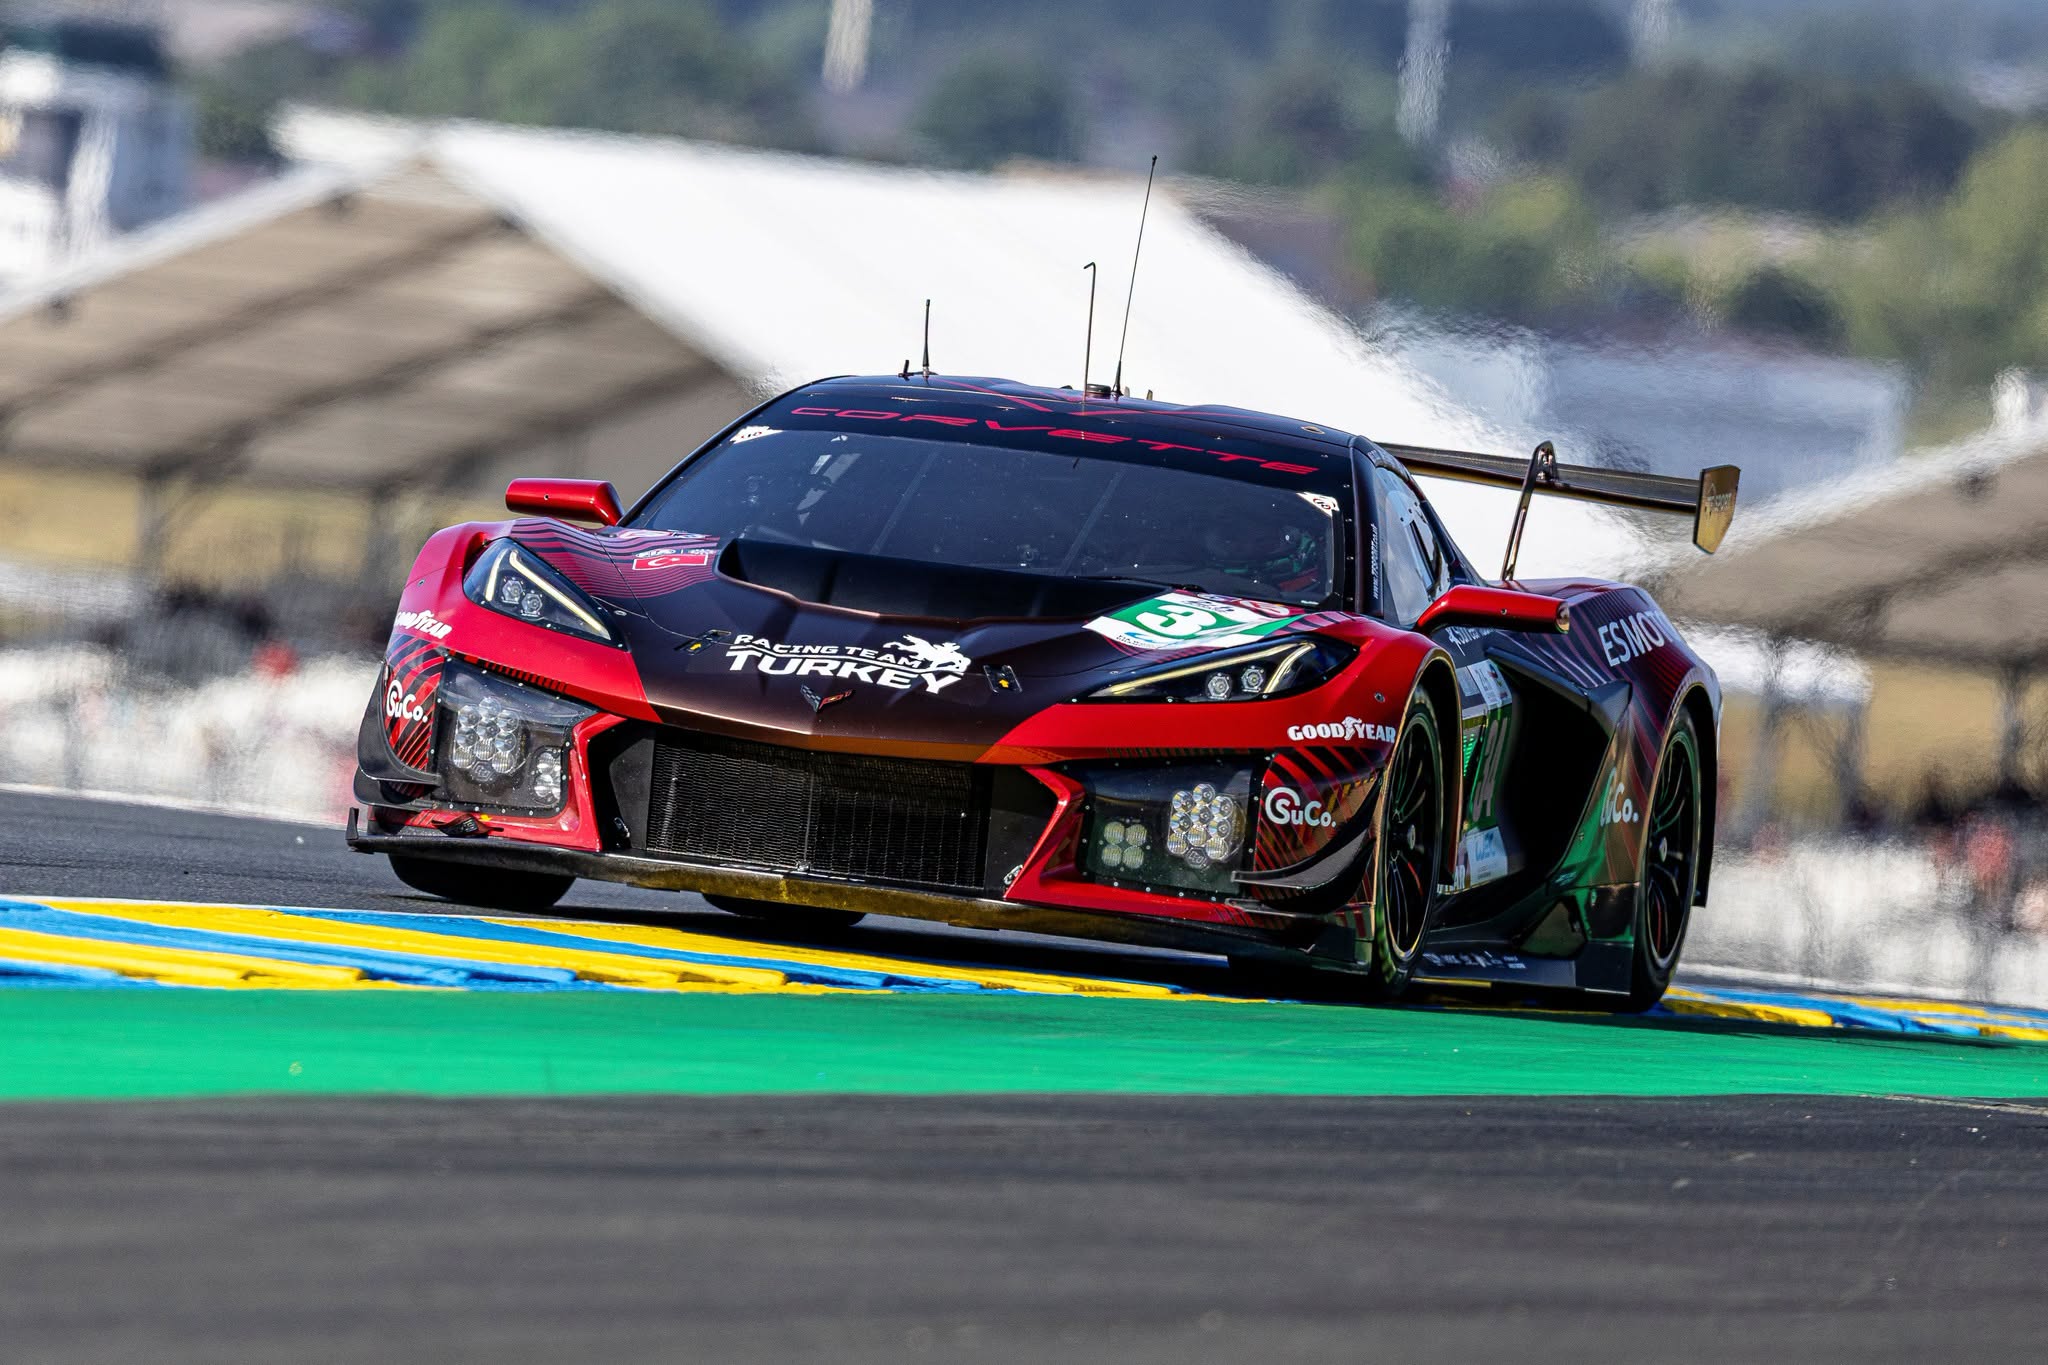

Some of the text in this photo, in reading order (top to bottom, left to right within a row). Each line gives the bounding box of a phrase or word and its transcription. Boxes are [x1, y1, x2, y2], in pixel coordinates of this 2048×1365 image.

[790, 407, 1320, 475] CORVETTE
[726, 650, 962, 694] TURKEY
[733, 634, 922, 669] RACING TEAM
